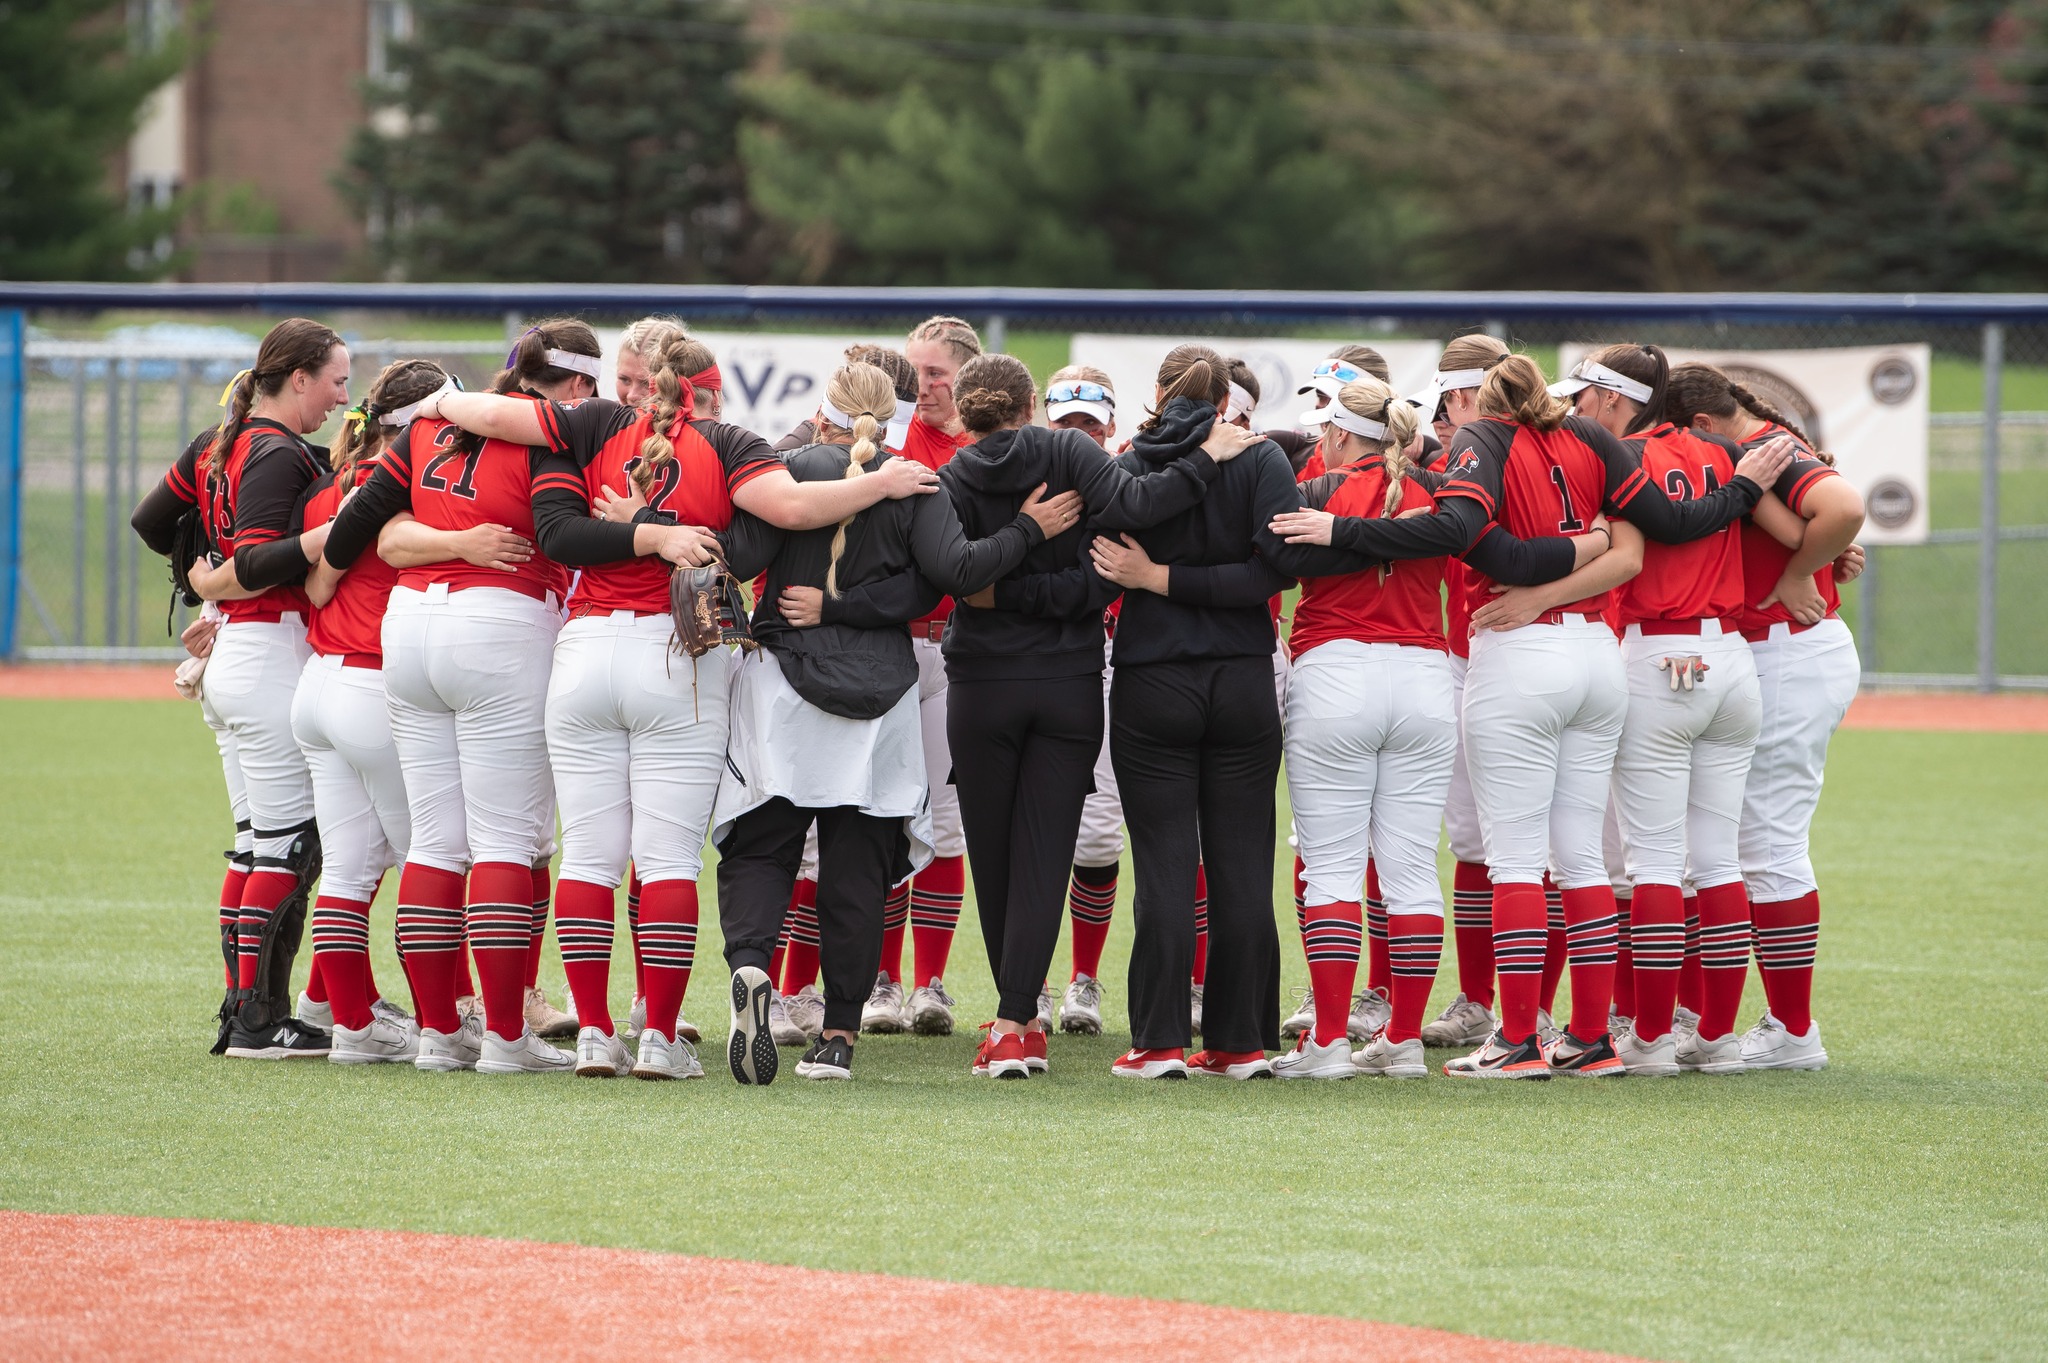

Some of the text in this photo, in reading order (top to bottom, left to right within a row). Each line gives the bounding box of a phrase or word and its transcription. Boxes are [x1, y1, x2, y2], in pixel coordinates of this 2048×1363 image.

[722, 361, 815, 411] VP
[420, 424, 488, 501] 21
[1551, 465, 1584, 533] 1
